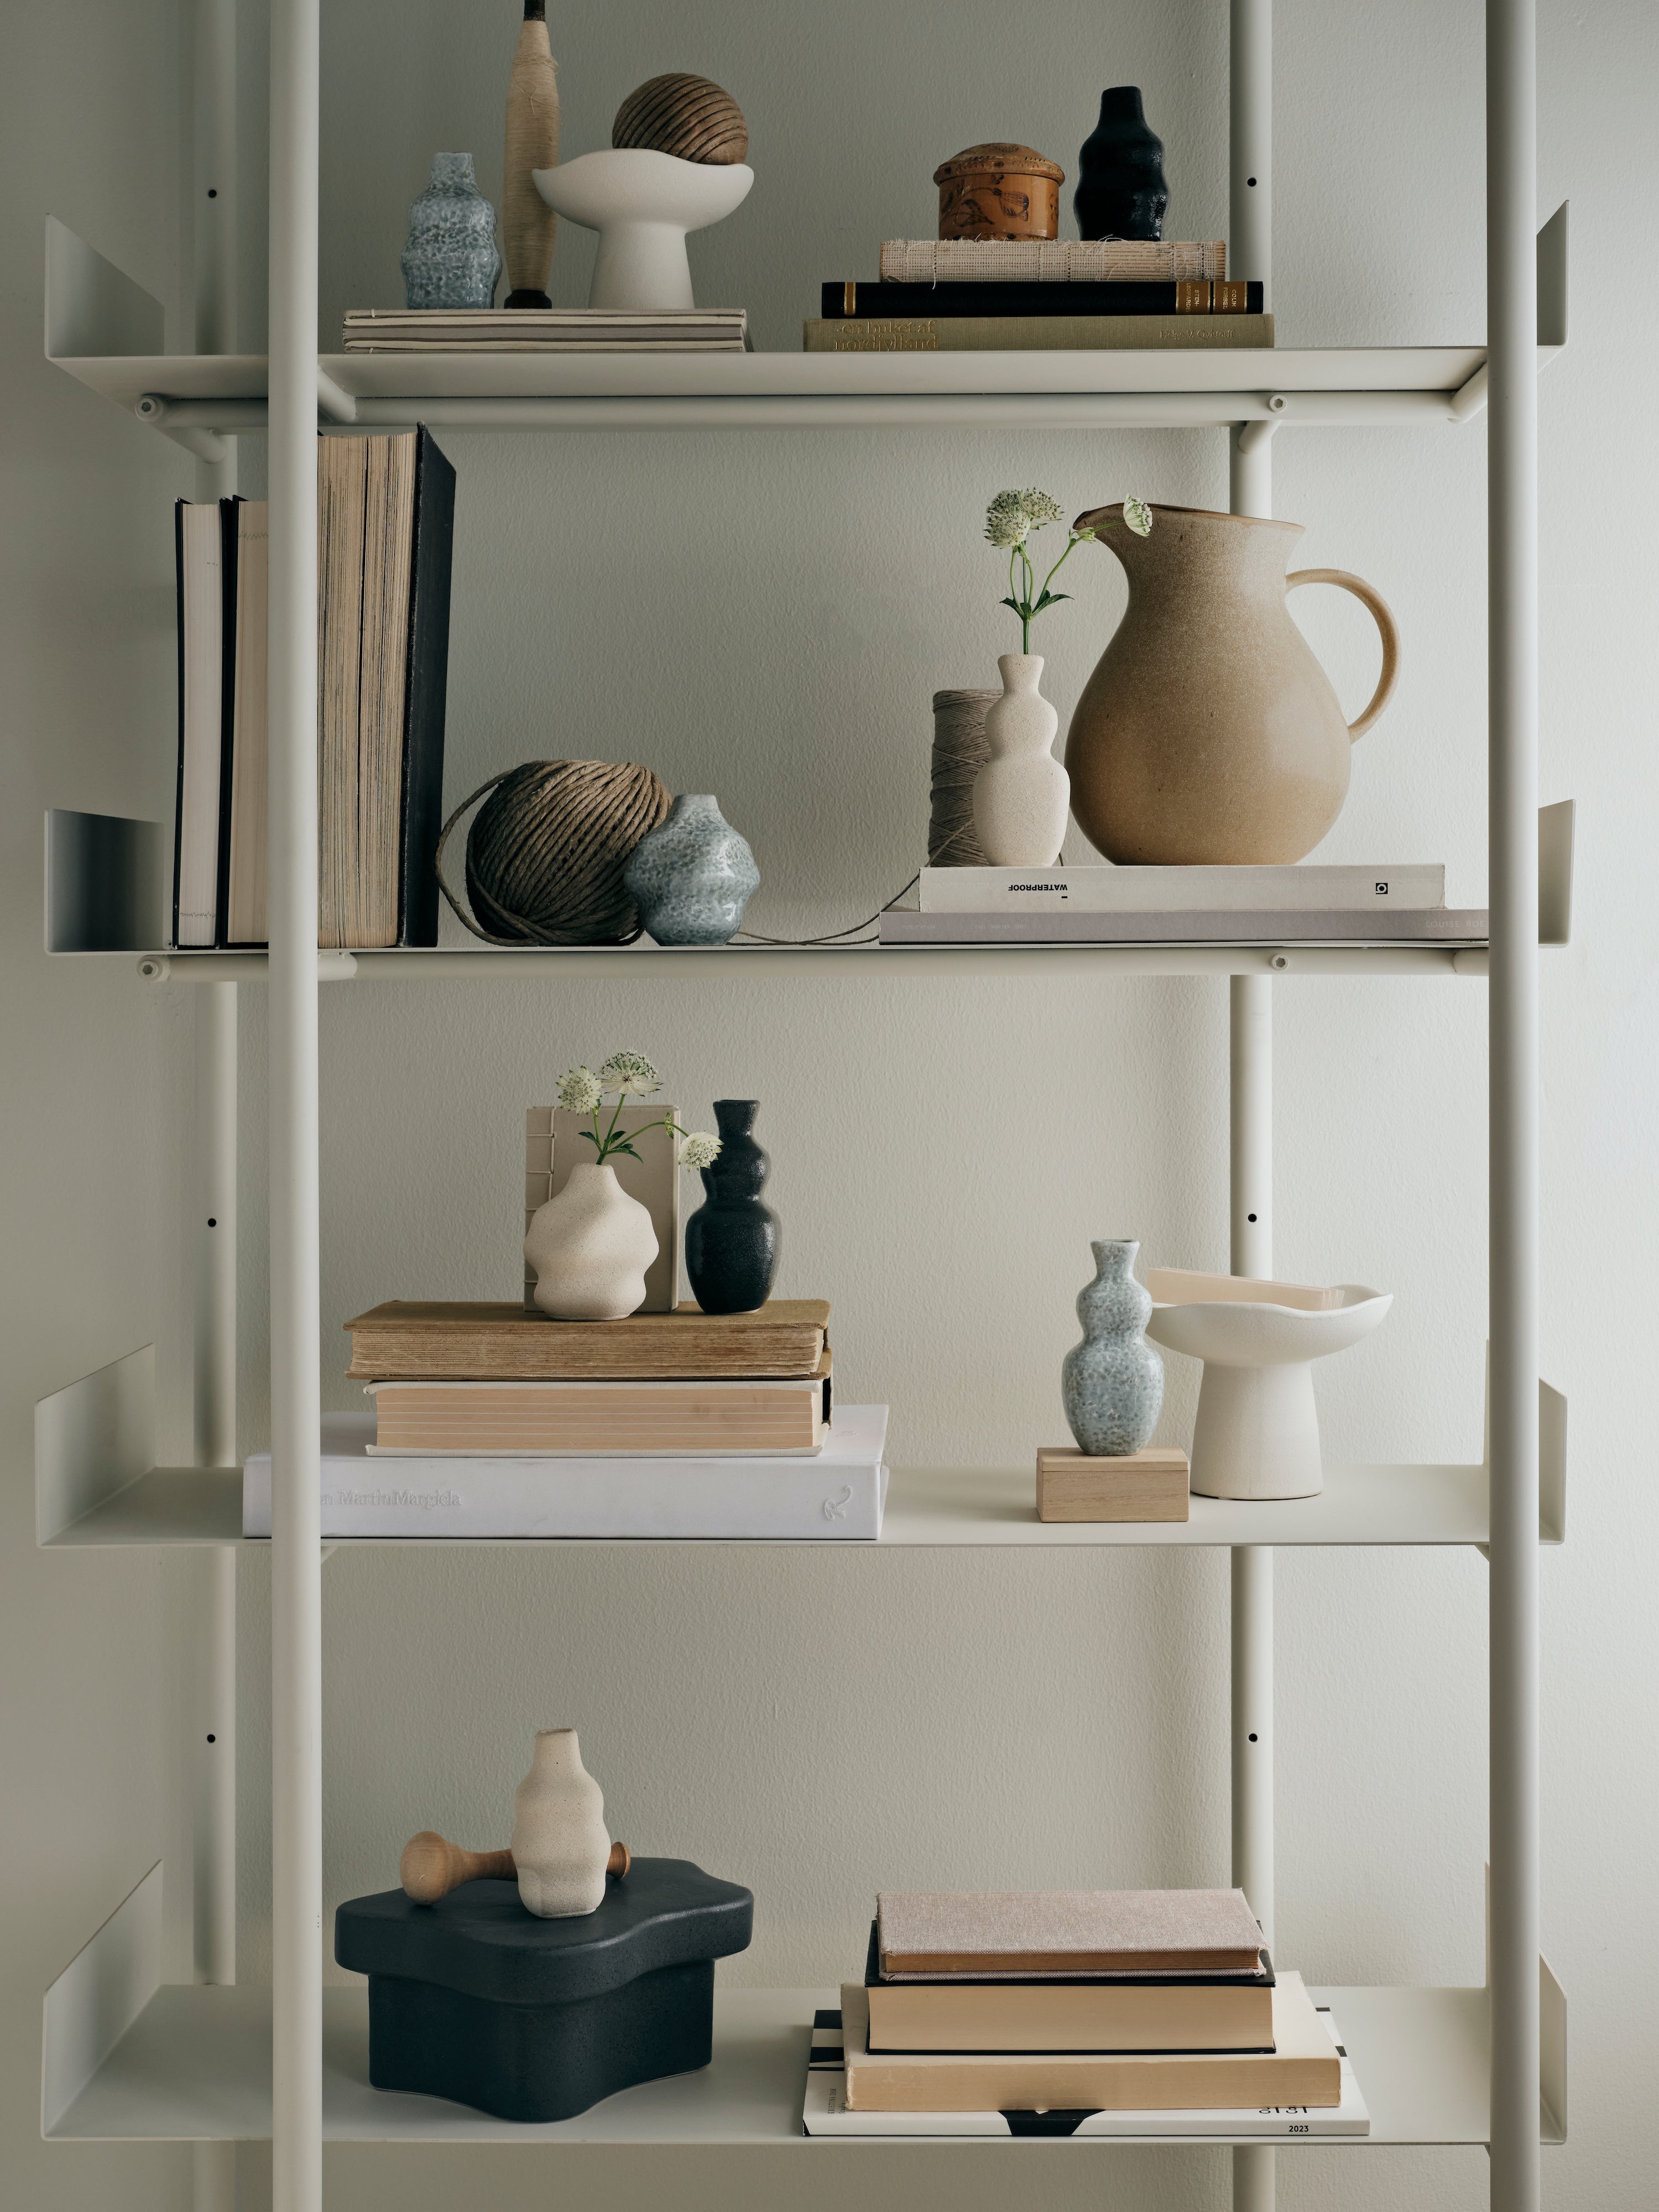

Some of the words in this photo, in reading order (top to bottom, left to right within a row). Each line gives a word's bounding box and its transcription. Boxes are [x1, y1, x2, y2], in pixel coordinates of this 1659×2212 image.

[867, 320, 912, 334] buket
[918, 319, 937, 333] af
[834, 333, 939, 352] nordjylland
[827, 2096, 836, 2114] KRISTINA
